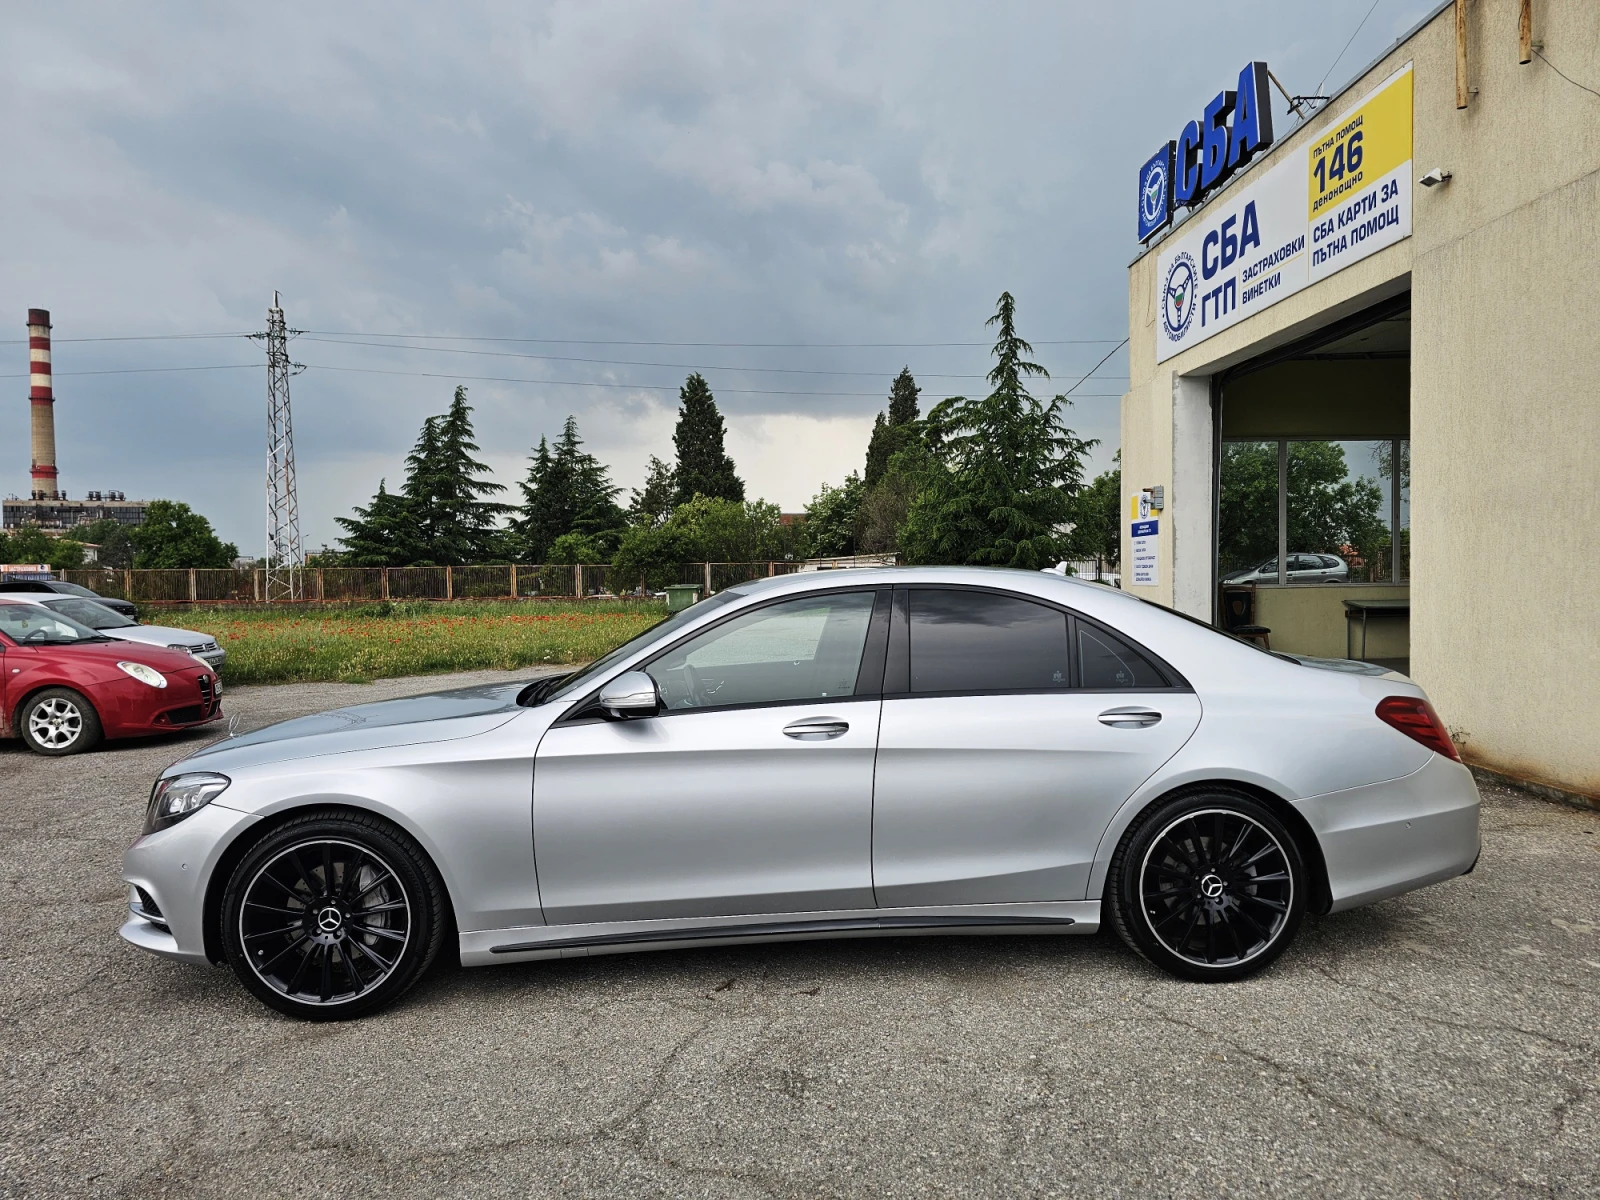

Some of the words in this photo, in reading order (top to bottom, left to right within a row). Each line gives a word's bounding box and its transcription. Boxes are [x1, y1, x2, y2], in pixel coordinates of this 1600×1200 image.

[1175, 61, 1262, 201] СБА
[1313, 137, 1335, 159] ПЪТНА
[1335, 115, 1363, 143] ПОМОЩ
[1313, 130, 1363, 194] 146
[1312, 171, 1363, 212] денонощно
[1313, 217, 1335, 243] СБА
[1337, 190, 1377, 230] КАРТИ
[1381, 178, 1398, 203] ЗА
[1201, 199, 1260, 281] СБА
[1242, 234, 1305, 283] ЗАСТРАХОВКИ
[1312, 235, 1347, 267] ПЪТНА
[1350, 204, 1399, 247] ПОМОЩ
[1161, 276, 1169, 309] СЪЮЗ
[1167, 262, 1175, 276] НА
[1201, 275, 1236, 328] ГТП
[1242, 271, 1281, 305] ВИНЕТКИ
